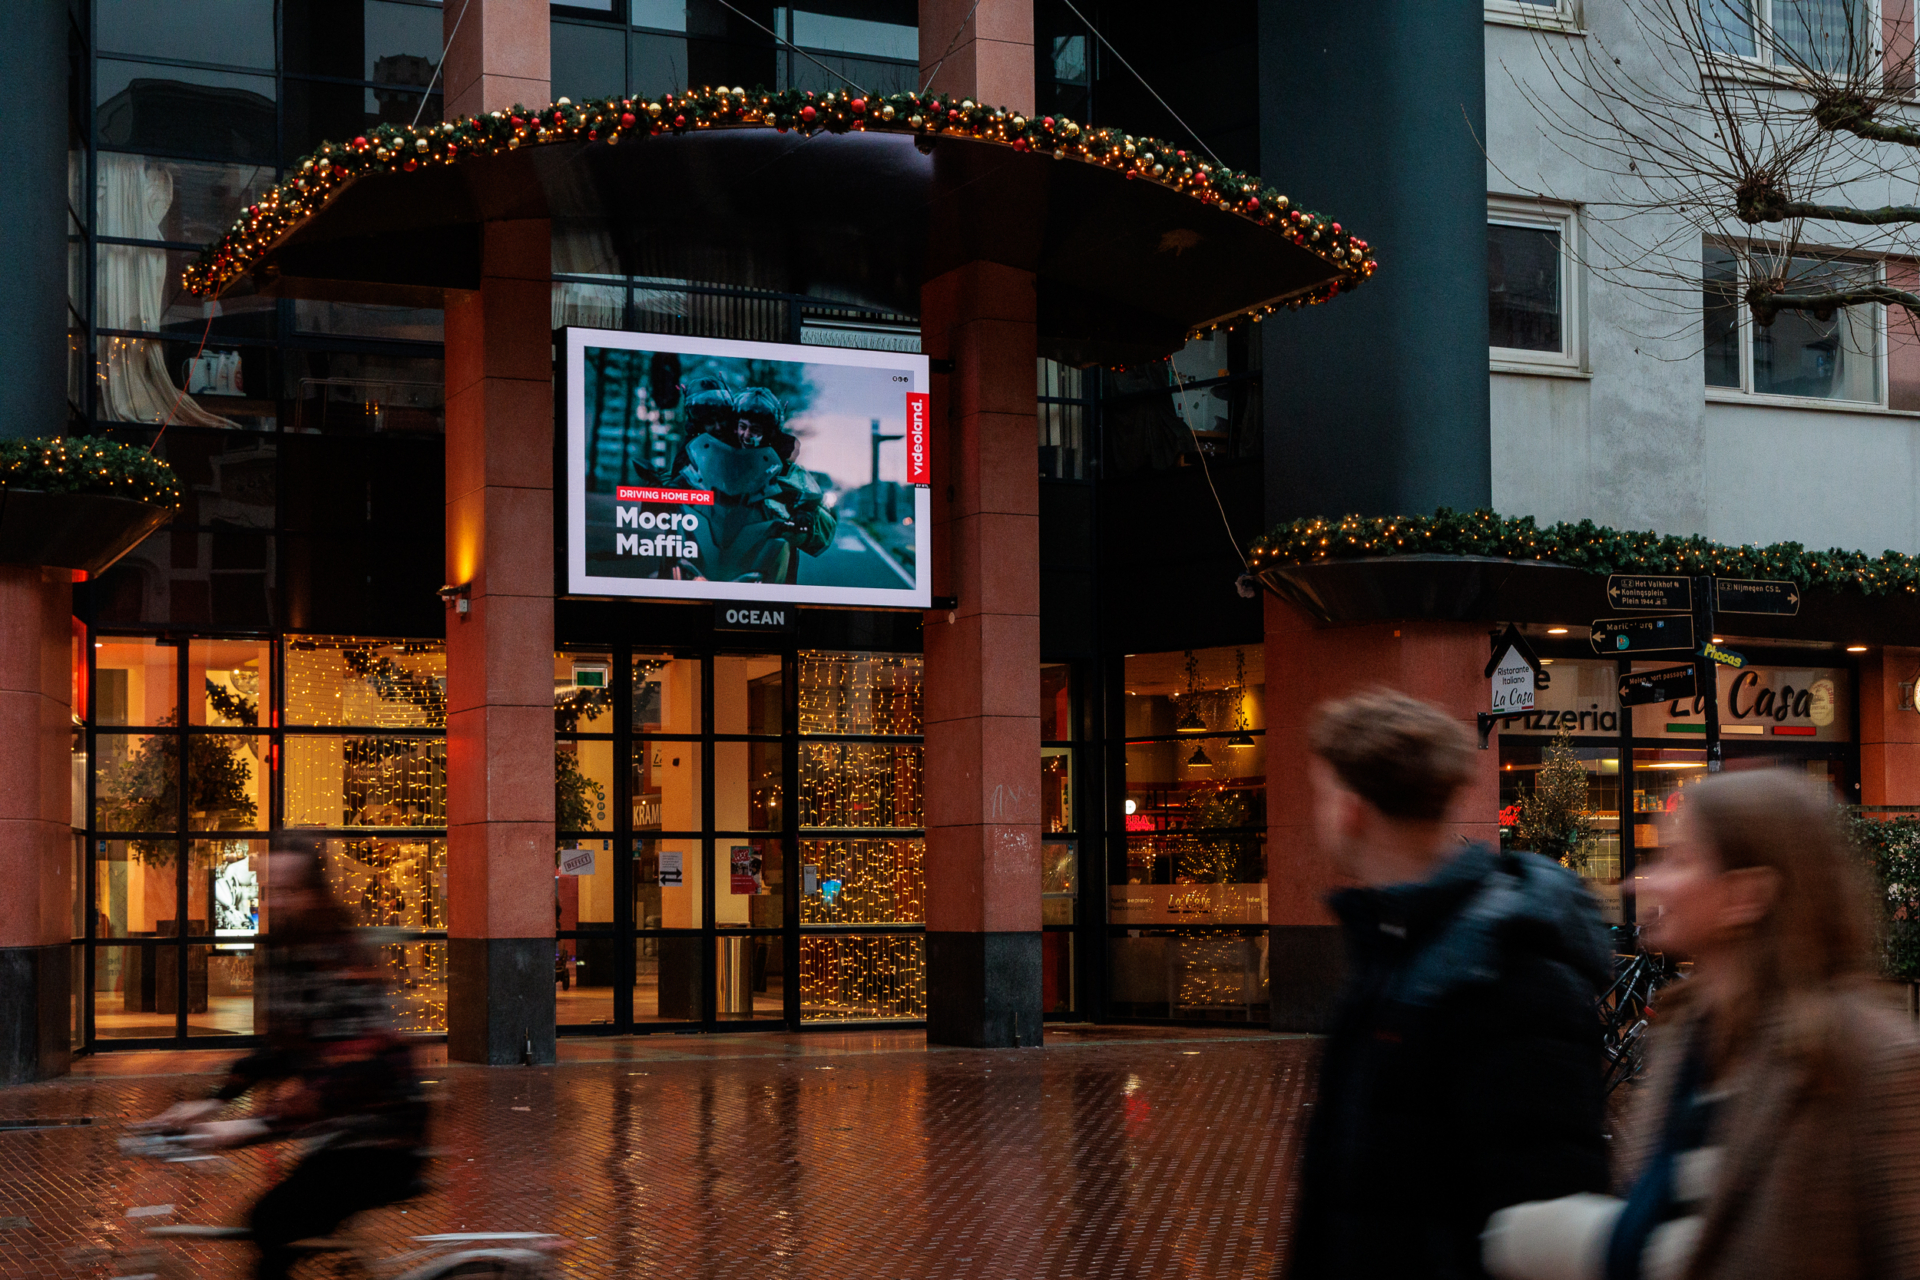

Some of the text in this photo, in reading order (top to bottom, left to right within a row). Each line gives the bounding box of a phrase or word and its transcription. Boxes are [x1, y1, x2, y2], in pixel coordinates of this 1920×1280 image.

[911, 399, 923, 476] videoland.
[620, 489, 710, 502] DRIVING HOME FOR
[616, 506, 699, 531] Mocro
[616, 533, 698, 558] Maffia
[1621, 589, 1664, 598] Koningsplein
[1733, 584, 1764, 593] Nijmegen
[725, 609, 785, 625] OCEAN
[1606, 622, 1653, 631] Mariurg
[1703, 643, 1742, 668] Phocas
[1497, 666, 1530, 676] Ristorante
[1662, 670, 1687, 680] passage
[1502, 676, 1525, 685] Italiano
[1493, 687, 1534, 707] La Casa
[1729, 670, 1812, 722] Casa
[633, 803, 662, 826] KRAM
[566, 856, 589, 870] DEFECT
